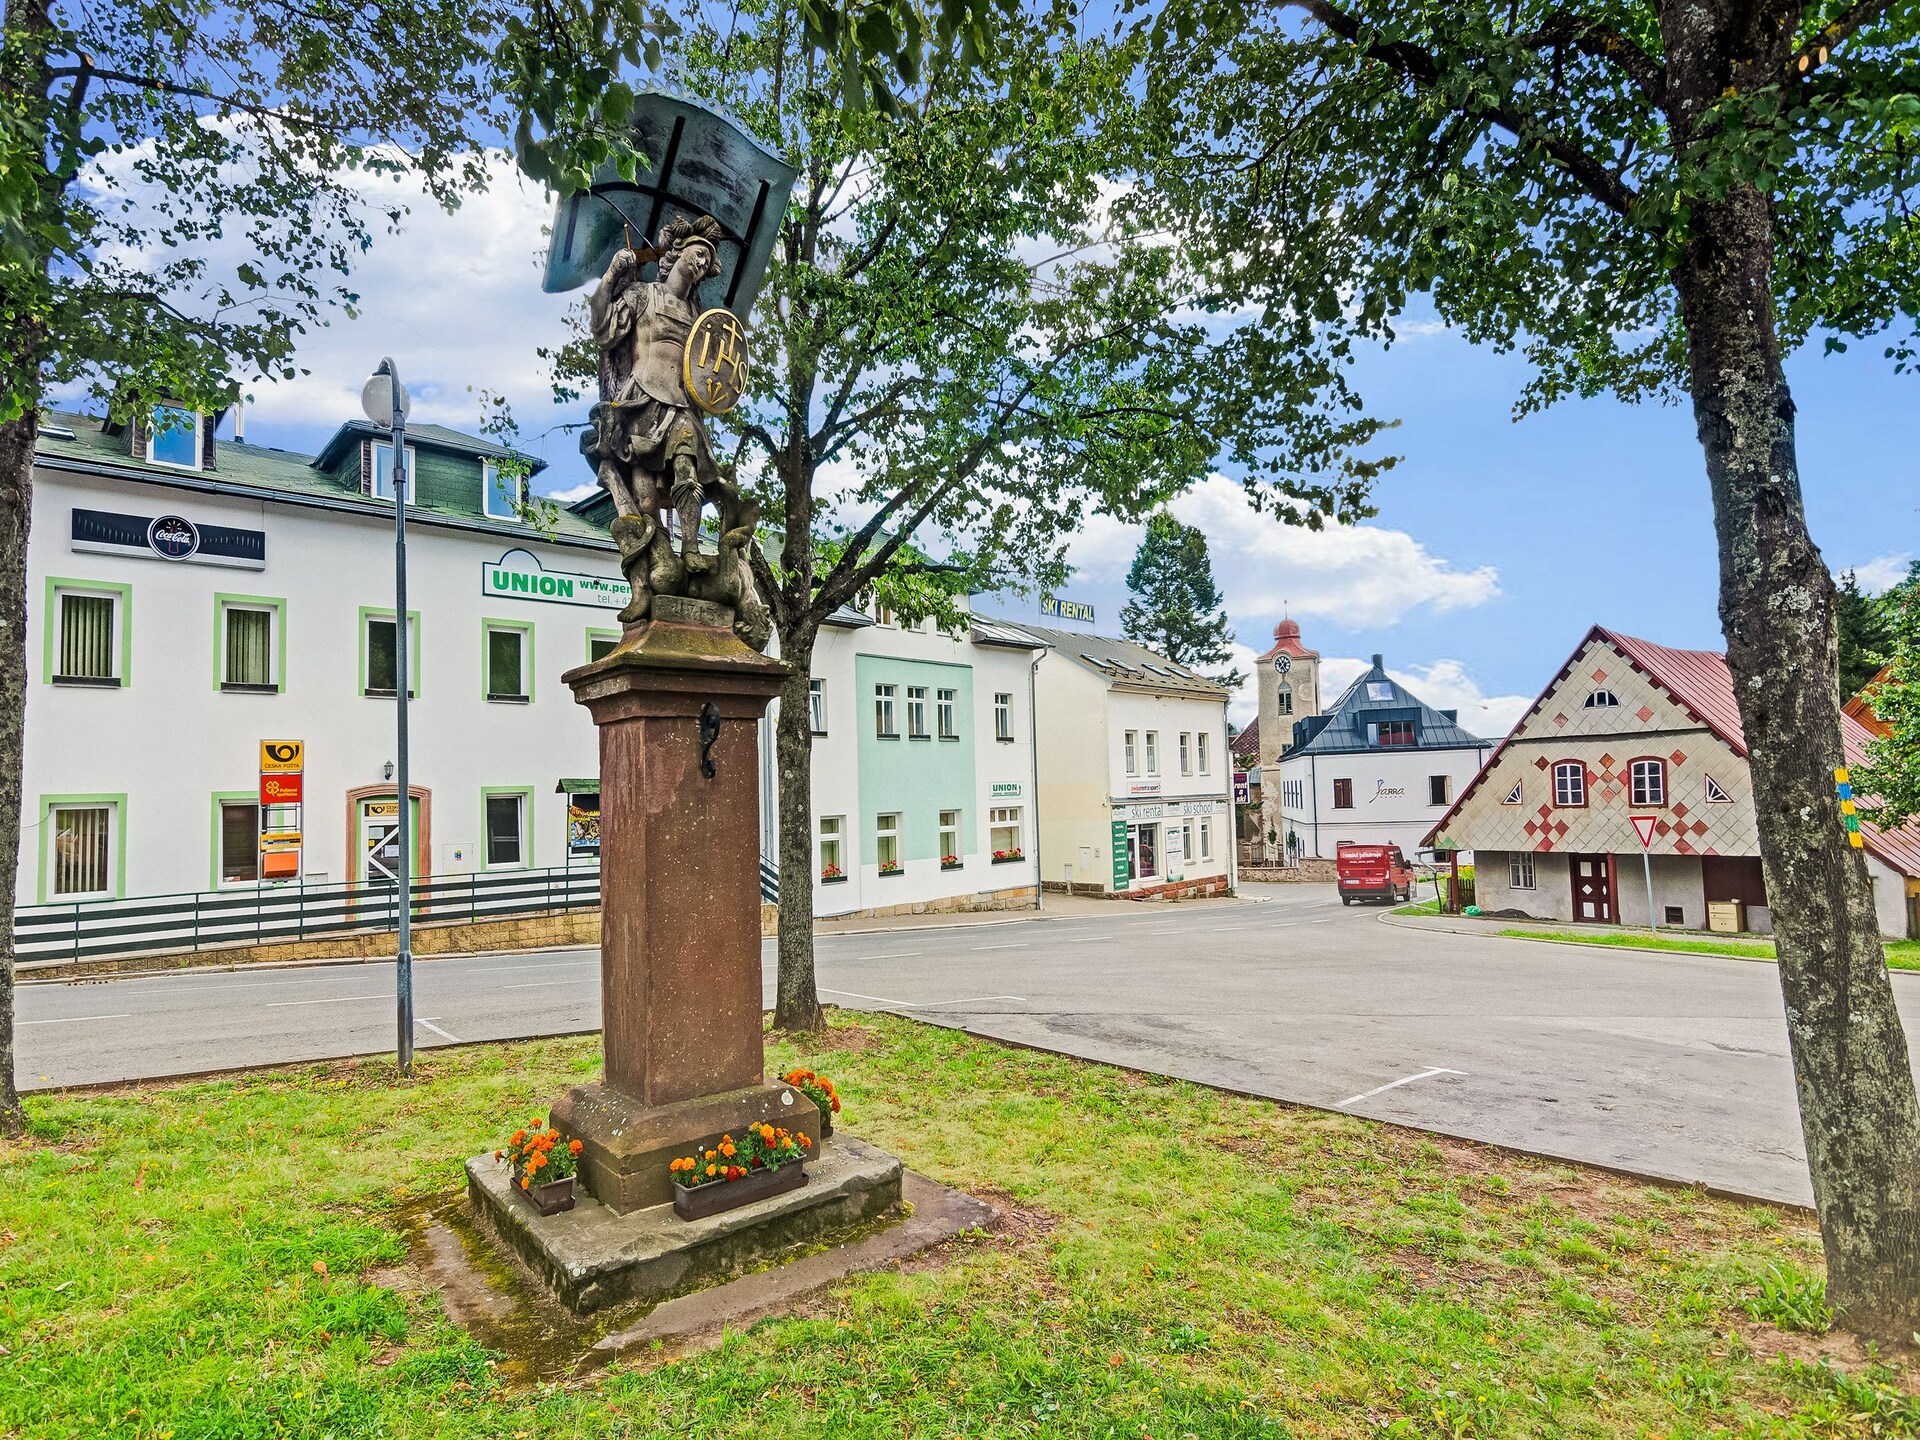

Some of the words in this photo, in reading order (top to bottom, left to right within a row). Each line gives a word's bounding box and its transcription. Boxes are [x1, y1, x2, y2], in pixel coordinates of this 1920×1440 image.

[155, 529, 191, 544] Coca-Cola
[492, 570, 574, 598] UNION
[597, 594, 613, 605] tel.
[1042, 598, 1058, 616] SKI
[1060, 601, 1094, 621] RENTAL
[992, 783, 1018, 791] UNION
[1131, 805, 1142, 818] ski
[1142, 803, 1163, 818] rental
[1183, 802, 1193, 815] ski
[1192, 801, 1213, 814] school
